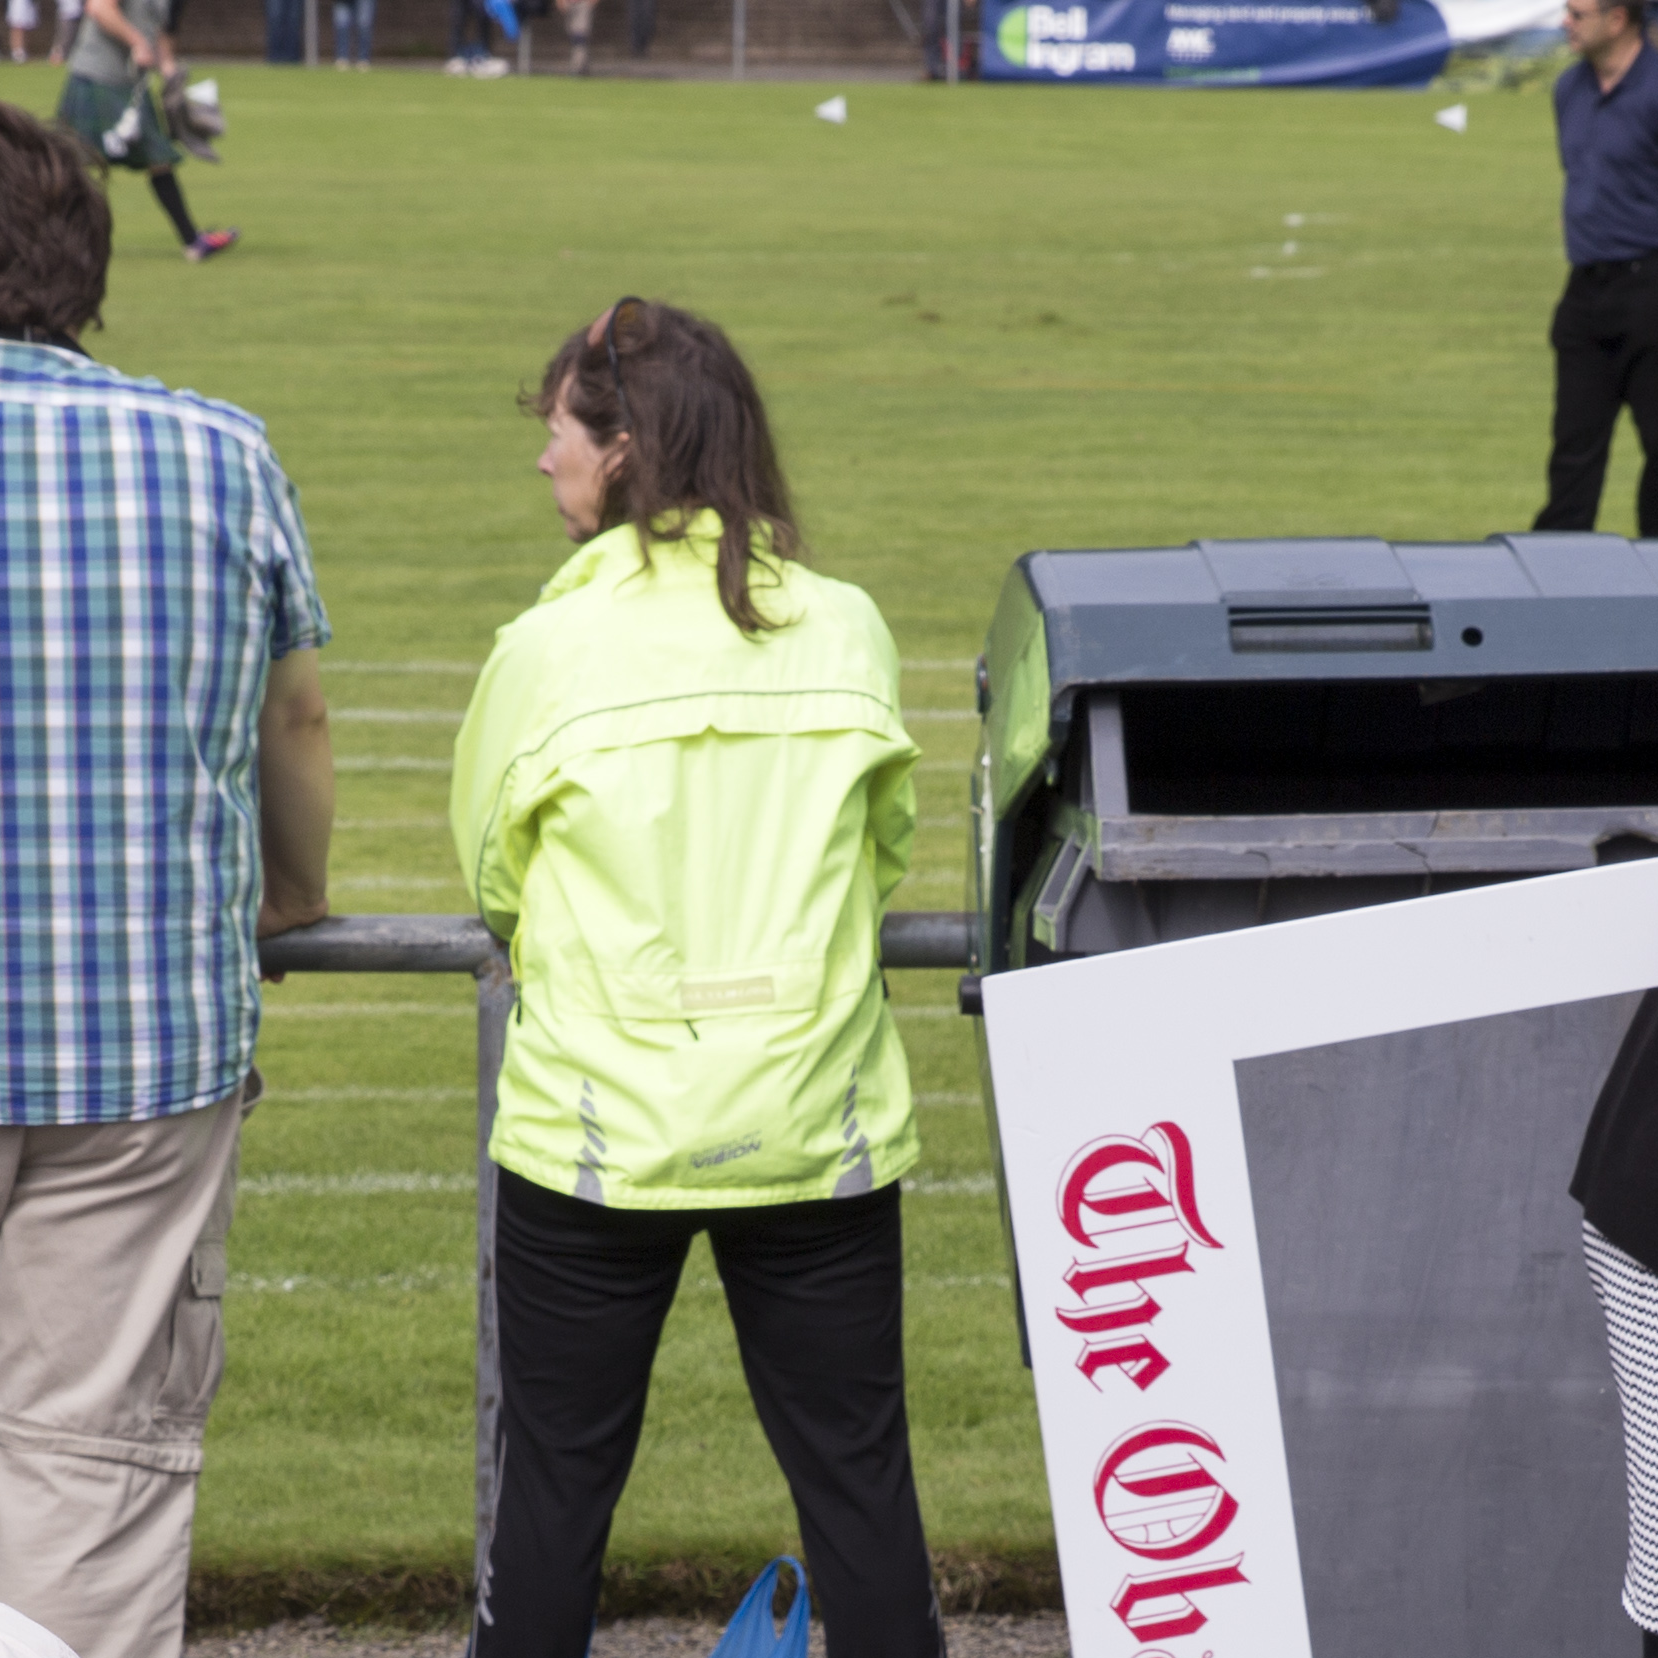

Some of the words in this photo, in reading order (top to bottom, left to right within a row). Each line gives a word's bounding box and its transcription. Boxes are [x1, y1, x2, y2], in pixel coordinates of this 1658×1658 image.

[1026, 5, 1088, 41] Bell
[1026, 40, 1136, 77] Ingram
[1055, 1120, 1224, 1392] The
